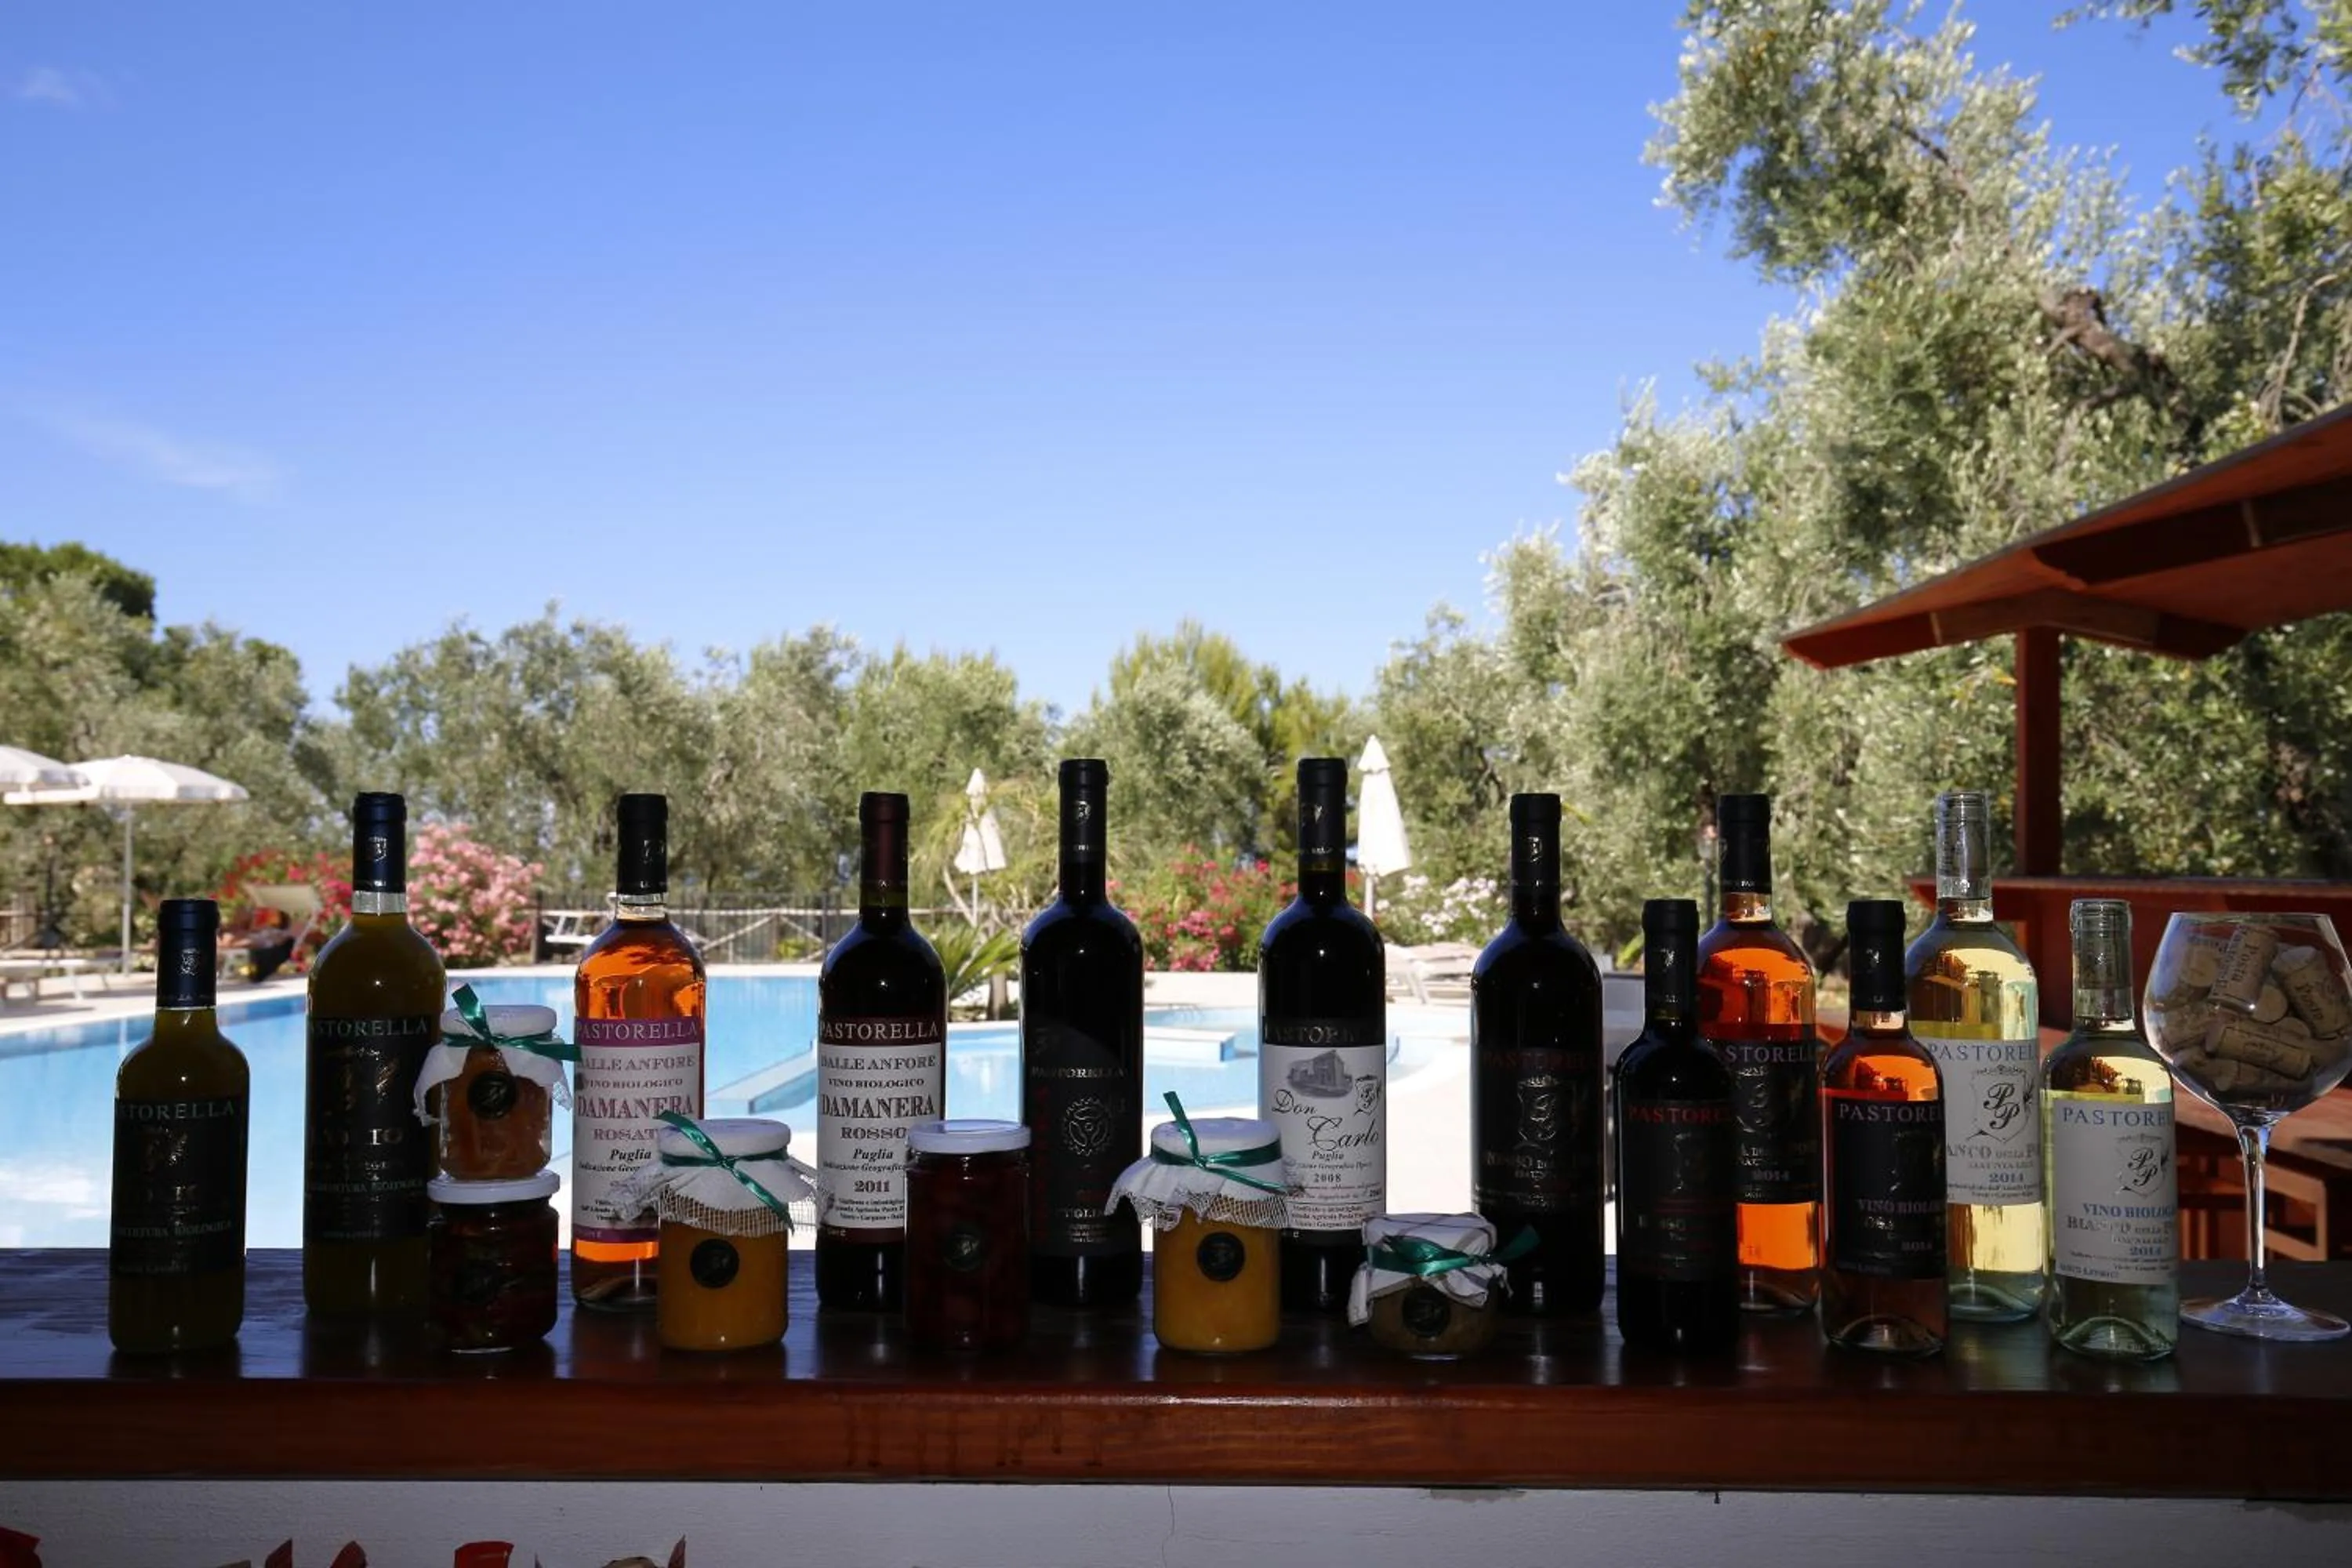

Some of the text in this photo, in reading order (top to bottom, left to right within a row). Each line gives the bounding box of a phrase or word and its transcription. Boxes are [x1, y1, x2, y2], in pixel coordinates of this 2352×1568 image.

[577, 1021, 698, 1040] PASTORELLA
[820, 1021, 938, 1040] PASTORELLA
[625, 1054, 696, 1071] ANFORE
[868, 1054, 935, 1070] ANFORE
[612, 1077, 683, 1089] BIOLOGICO
[855, 1077, 924, 1089] BIOLOGICO
[577, 1094, 694, 1120] DAMANERA
[821, 1094, 935, 1119] DAMANERA
[1271, 1088, 1317, 1114] Don
[593, 1127, 659, 1141] ROSAT
[1307, 1116, 1381, 1152] Carlo
[609, 1148, 652, 1162] Puglia
[852, 1148, 895, 1163] Puglia
[1312, 1150, 1345, 1162] Puglia
[1947, 1142, 1992, 1159] ANCO
[854, 1180, 890, 1192] 2011
[1313, 1173, 1342, 1183] 2008
[2082, 1203, 2122, 1217] VINO
[2066, 1216, 2132, 1234] BIAO
